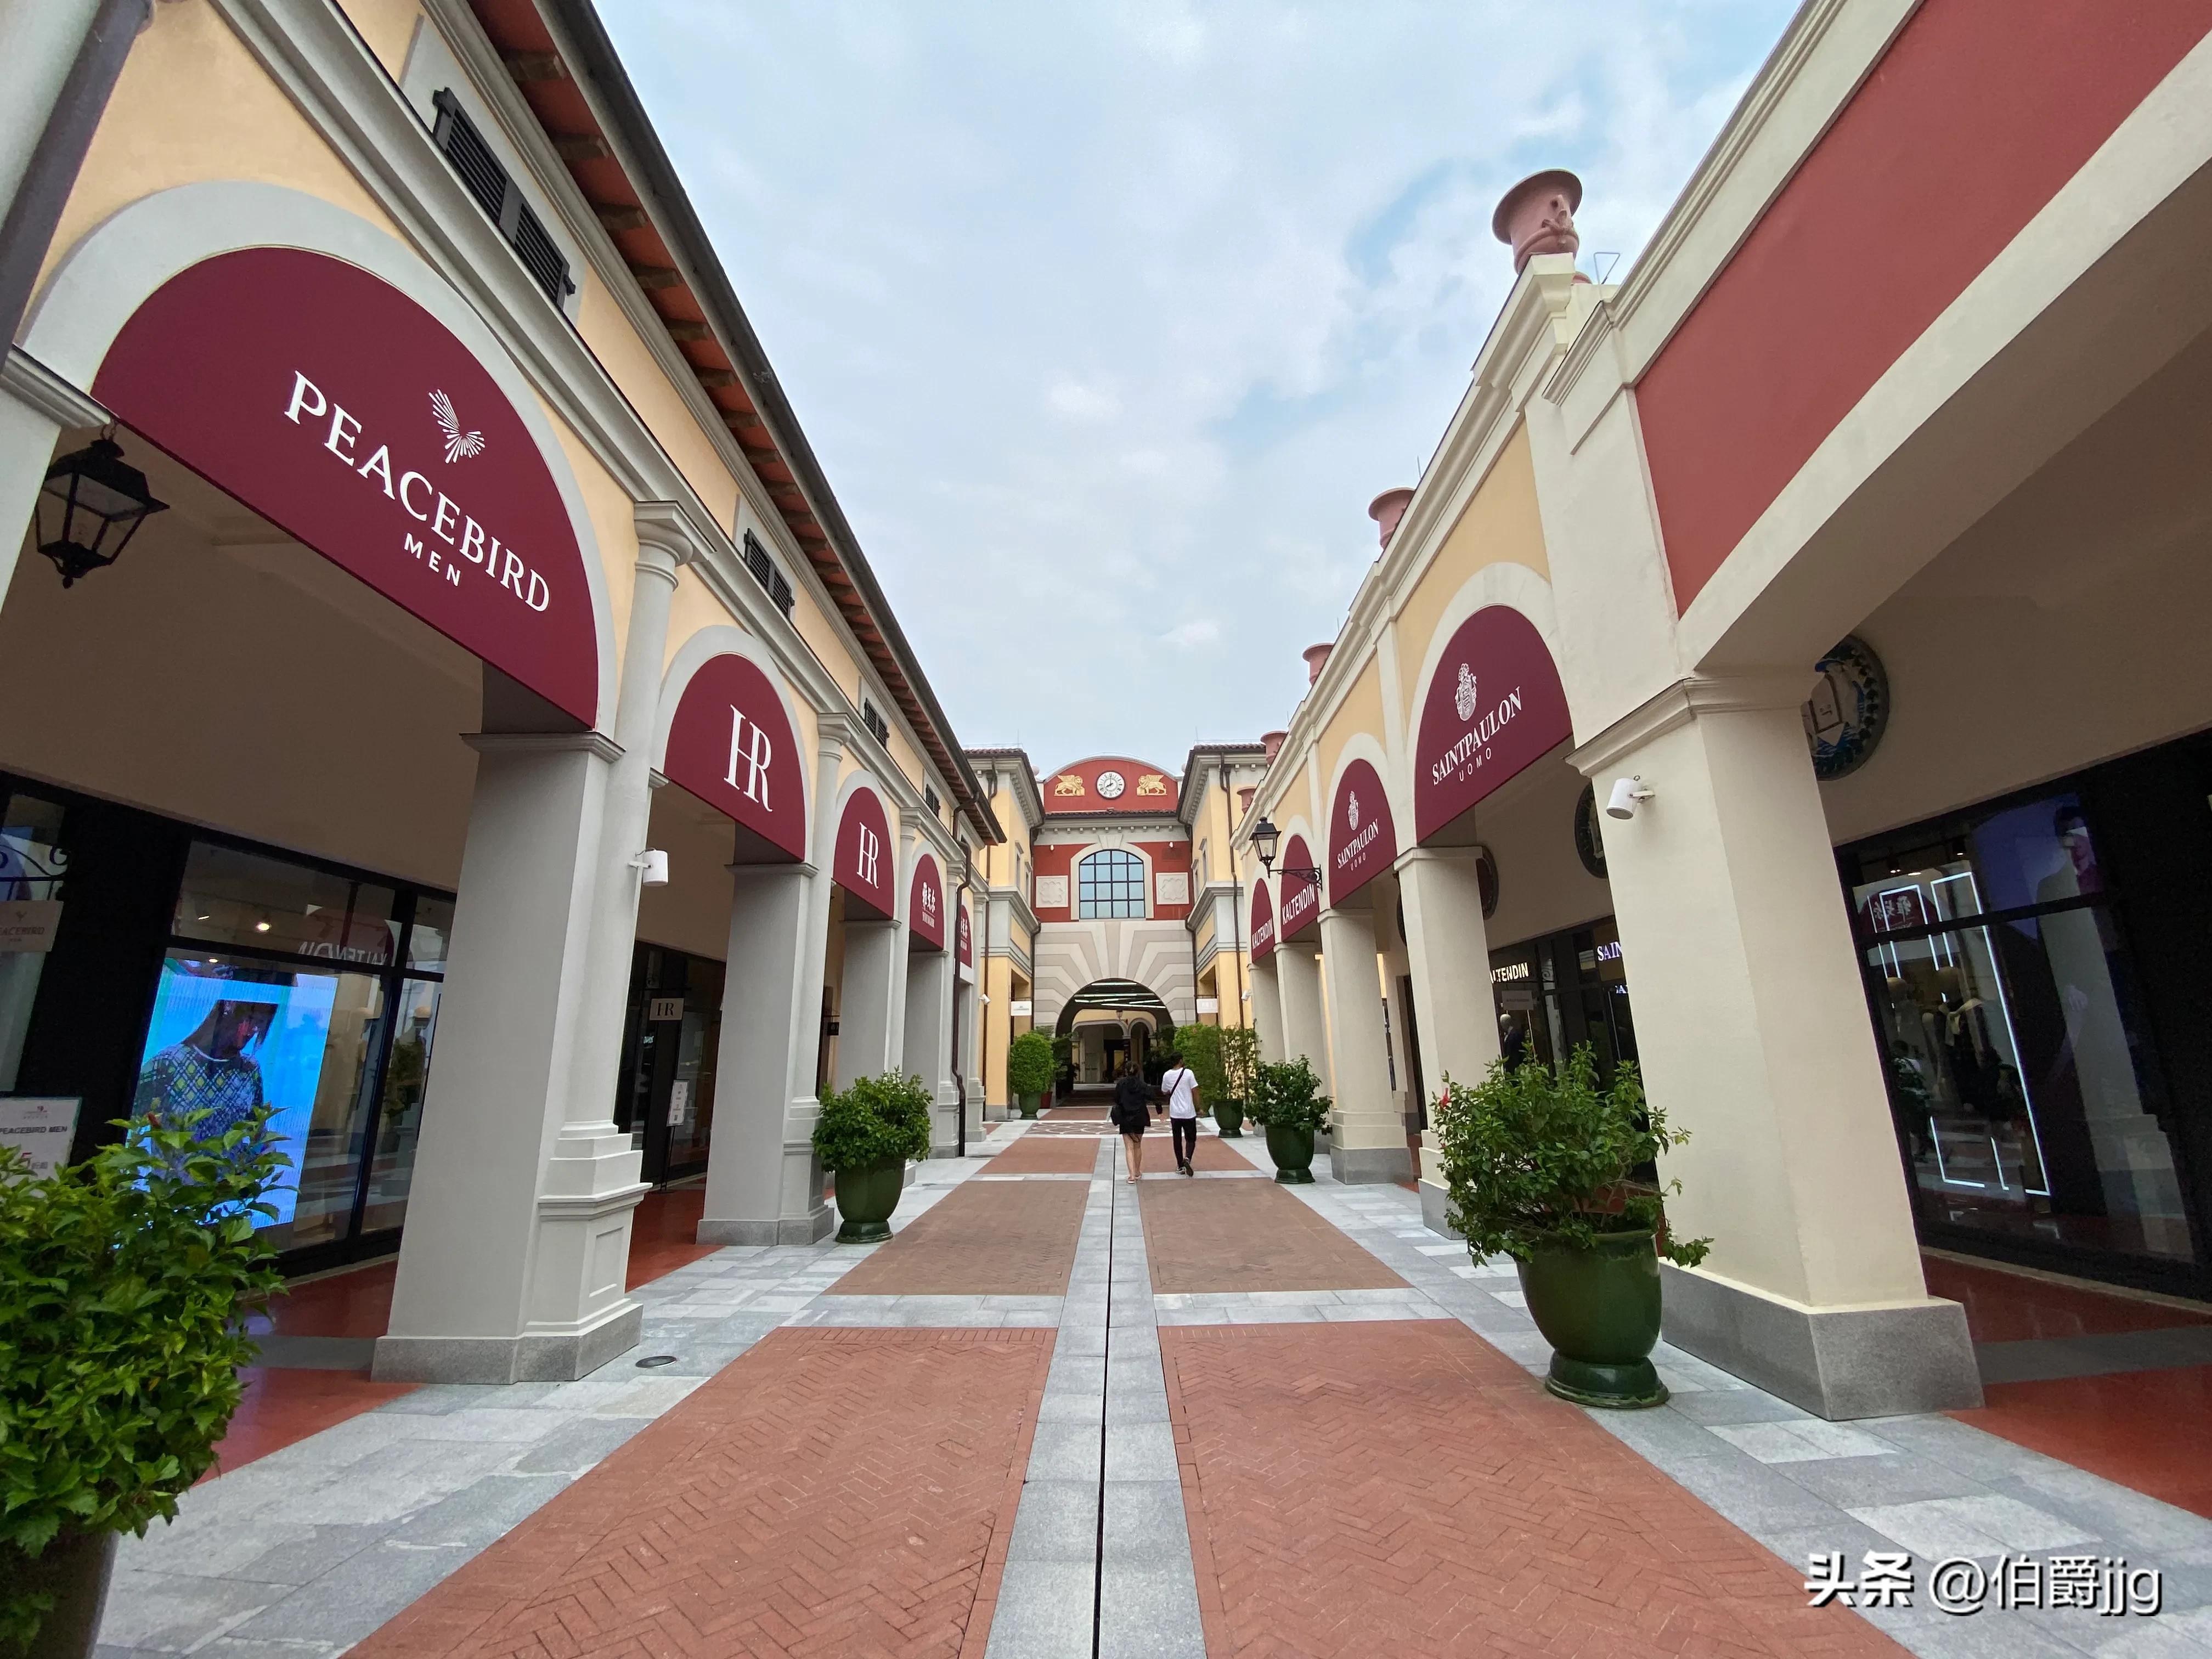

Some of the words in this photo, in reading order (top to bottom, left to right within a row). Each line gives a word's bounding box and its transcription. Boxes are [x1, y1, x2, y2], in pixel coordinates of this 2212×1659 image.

[284, 370, 549, 612] PEACEBIRD
[403, 532, 461, 587] MEN
[723, 704, 773, 812] HR
[1432, 686, 1522, 786] SAINTPAULON
[1459, 747, 1492, 782] UOMO
[856, 821, 879, 889] HR
[1337, 818, 1379, 869] SAINTPAULON
[1350, 852, 1366, 871] UOMO
[1282, 883, 1315, 926] KALTENDIN
[1251, 917, 1273, 950] KALTENDIN
